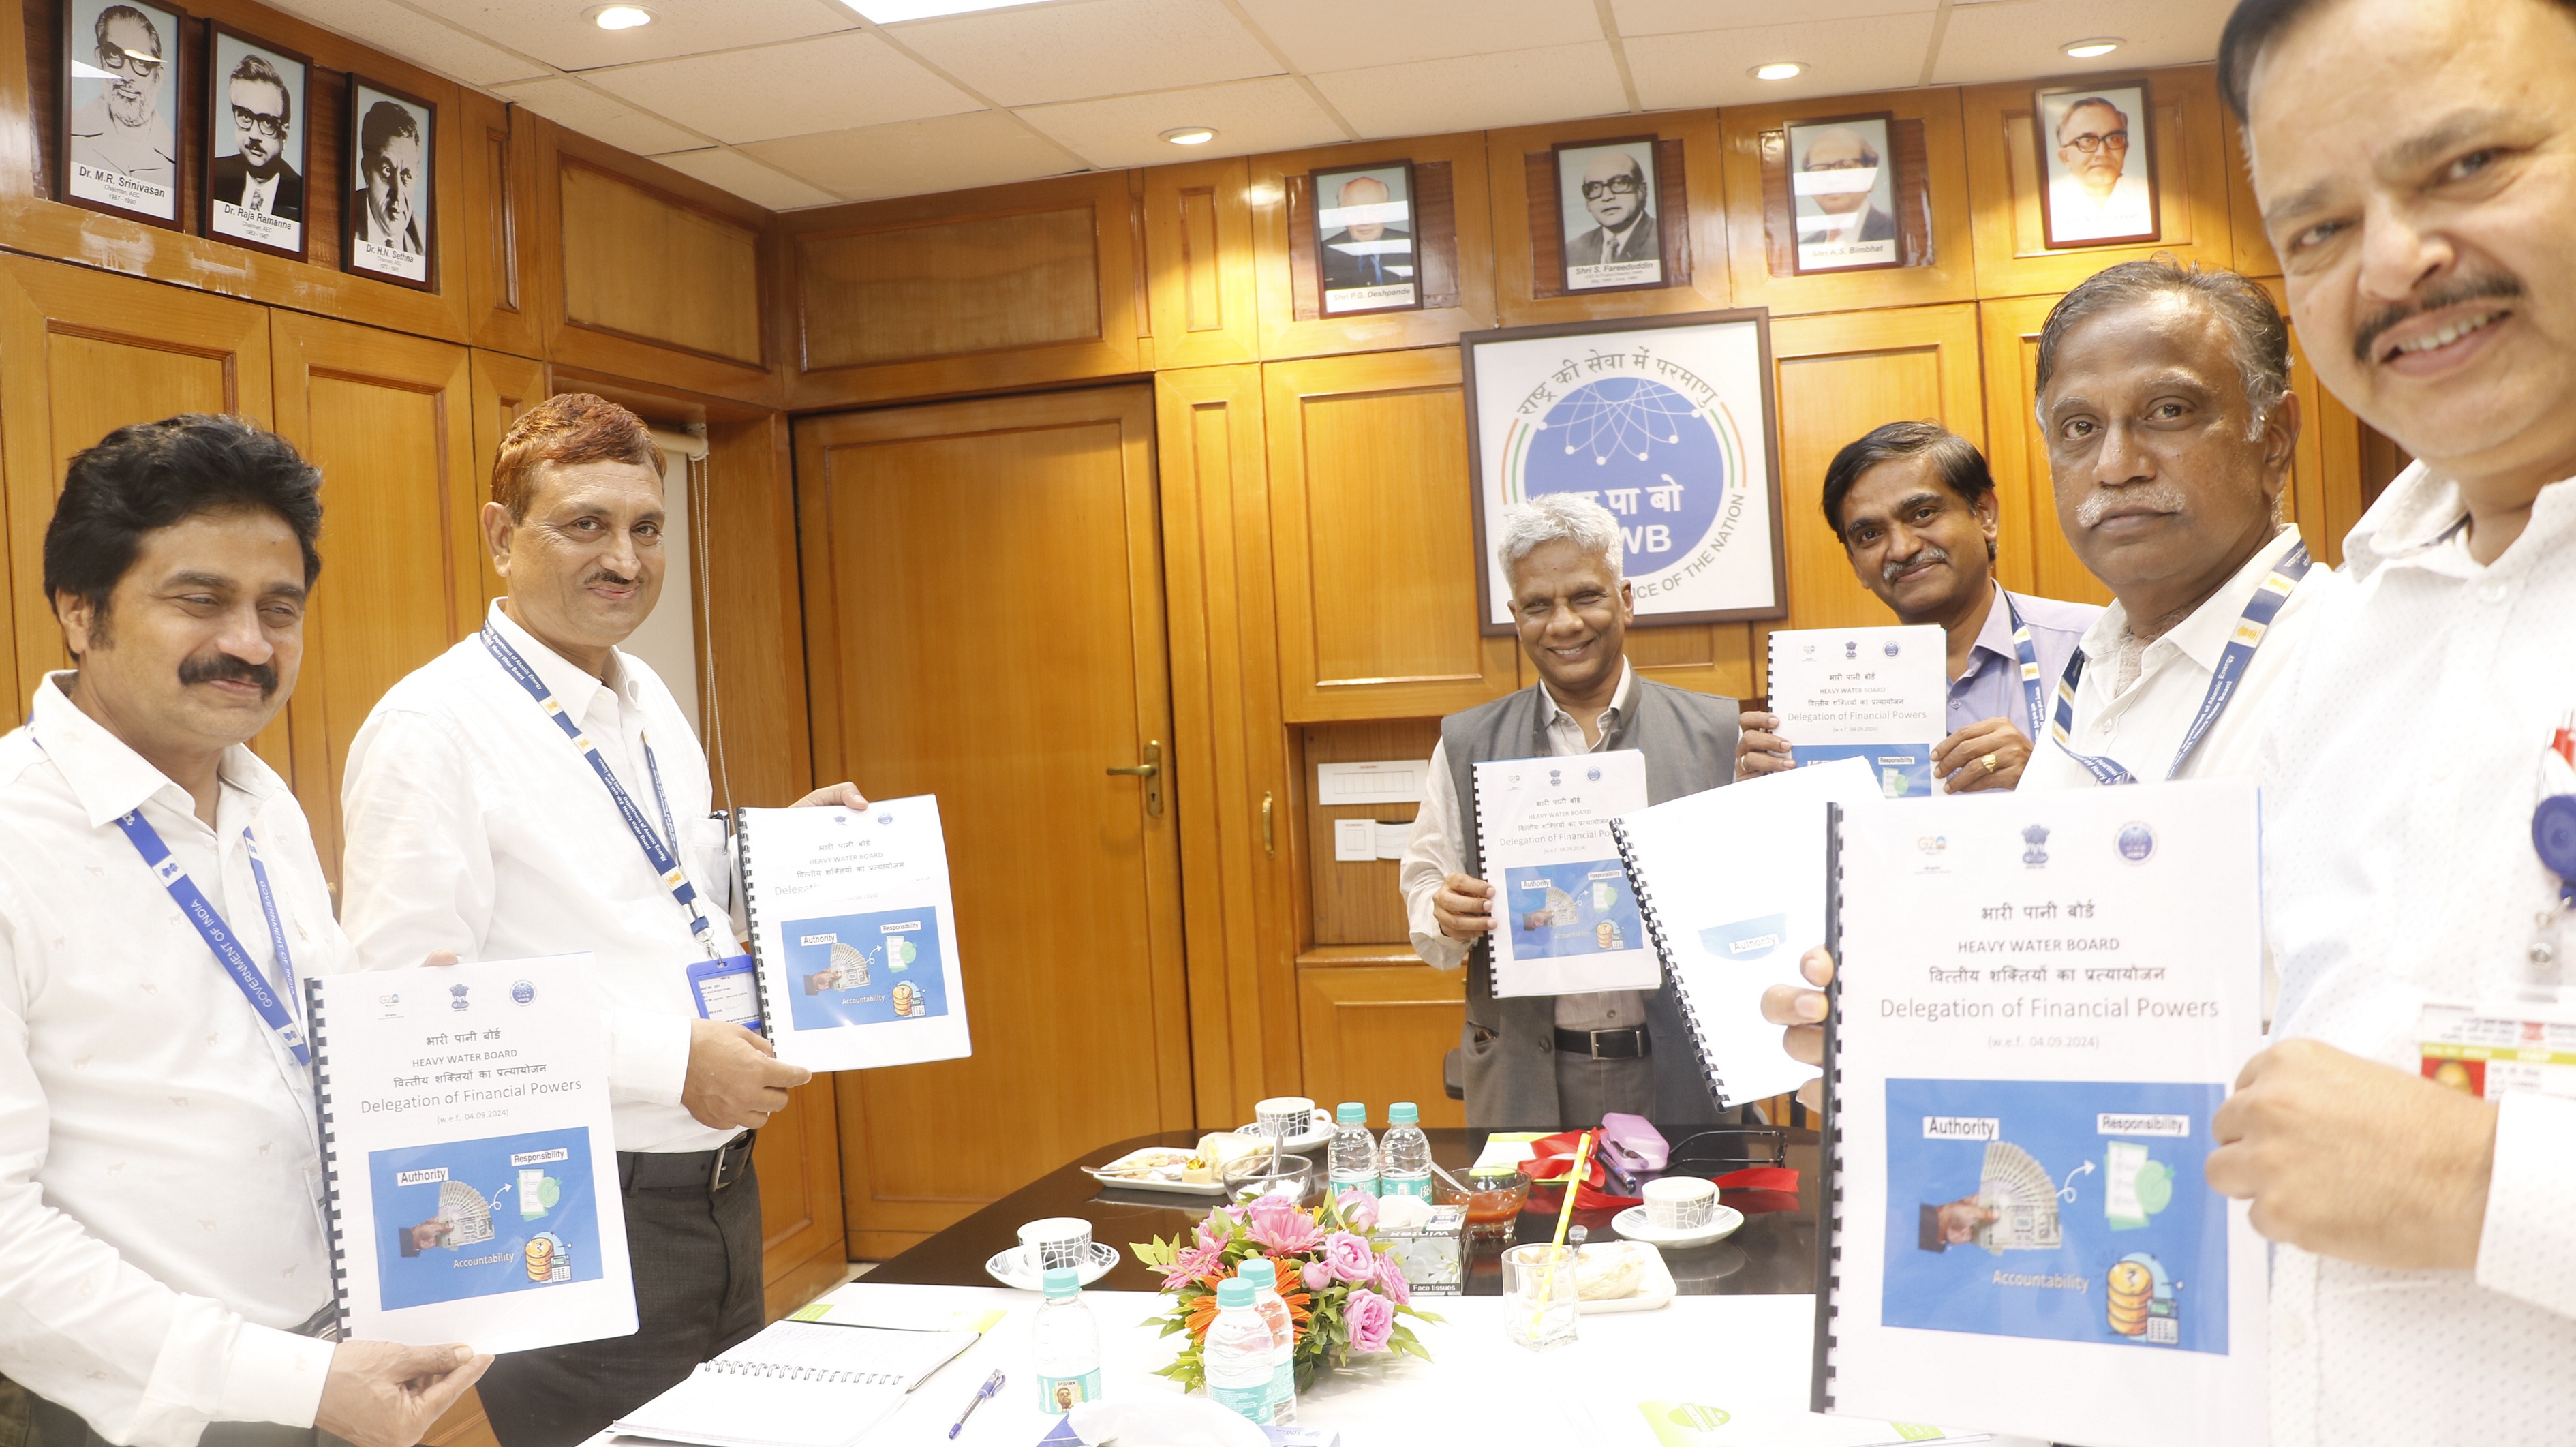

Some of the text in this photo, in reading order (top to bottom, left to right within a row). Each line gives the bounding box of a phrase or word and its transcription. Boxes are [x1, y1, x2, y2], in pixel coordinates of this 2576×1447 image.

[80, 166, 165, 197] Dr. M.R. Srinivasan
[105, 185, 127, 195] Chairman,
[224, 204, 291, 230] Dr. Raja Ramanna
[367, 244, 413, 262] Dr. H.N. Sethna
[1850, 245, 1883, 254] Bimbhat
[1604, 262, 1653, 271] Fareeduddin
[1368, 288, 1410, 298] Deshpande
[1517, 346, 1718, 416] राष्ट्र की सेवा में परमाणु
[1606, 474, 1685, 515] पा बो
[1662, 493, 1745, 592] OF THE NATION
[492, 645, 525, 680] Heavy Water Board
[493, 635, 512, 656] Department
[515, 660, 530, 675] Atomic
[528, 674, 542, 690] Energy
[2208, 681, 2222, 705] Atomic
[2218, 655, 2235, 680] Energy
[2207, 703, 2221, 720] Water
[2218, 681, 2232, 701] Board
[1788, 713, 1835, 722] Delegation
[1850, 711, 1890, 719] Financial
[2091, 765, 2106, 780] Heavy
[1537, 799, 1549, 807] भारी
[1570, 796, 1581, 804] बोर्ड
[622, 806, 651, 850] Heavy Water Board
[624, 797, 642, 823] Department
[644, 828, 656, 844] Atomic
[655, 844, 667, 862] Energy
[818, 842, 834, 851] भारी
[859, 839, 871, 847] बोर्ड
[1499, 836, 1546, 847] Delegation
[1559, 832, 1594, 840] Financial
[833, 855, 858, 863] WATER
[859, 852, 883, 860] BOARD
[1982, 899, 2095, 921] भारी पानी बोर्ड
[260, 881, 284, 950] GOVERNMENT
[281, 951, 289, 966] OF
[883, 923, 919, 931] Responsibility
[803, 934, 835, 944] Authority
[1734, 935, 1776, 951] Authority
[1959, 938, 2119, 952] HEAVY WATER BOARD
[191, 899, 272, 1007] GOVERNMENT OF INDIA
[842, 994, 885, 1005] Accountability
[1881, 997, 2218, 1022] Delegation of Financial Powers
[427, 1028, 501, 1046] भारी पानी बोर्ड
[412, 1049, 518, 1067] HEAVY WATER BOARD
[394, 1064, 547, 1088] वित्तीय शक्तियों का प्रत्यायोजन
[361, 1079, 582, 1114] Delegation of Financial Powers
[464, 1109, 509, 1121] 04.09.2024)
[1929, 1117, 1995, 1140] Authority
[2103, 1116, 2183, 1133] Responsibility
[514, 1150, 565, 1163] Responsibility
[401, 1168, 446, 1183] Authority
[453, 1253, 514, 1268] Accountability
[1993, 1270, 2089, 1293] Accountability
